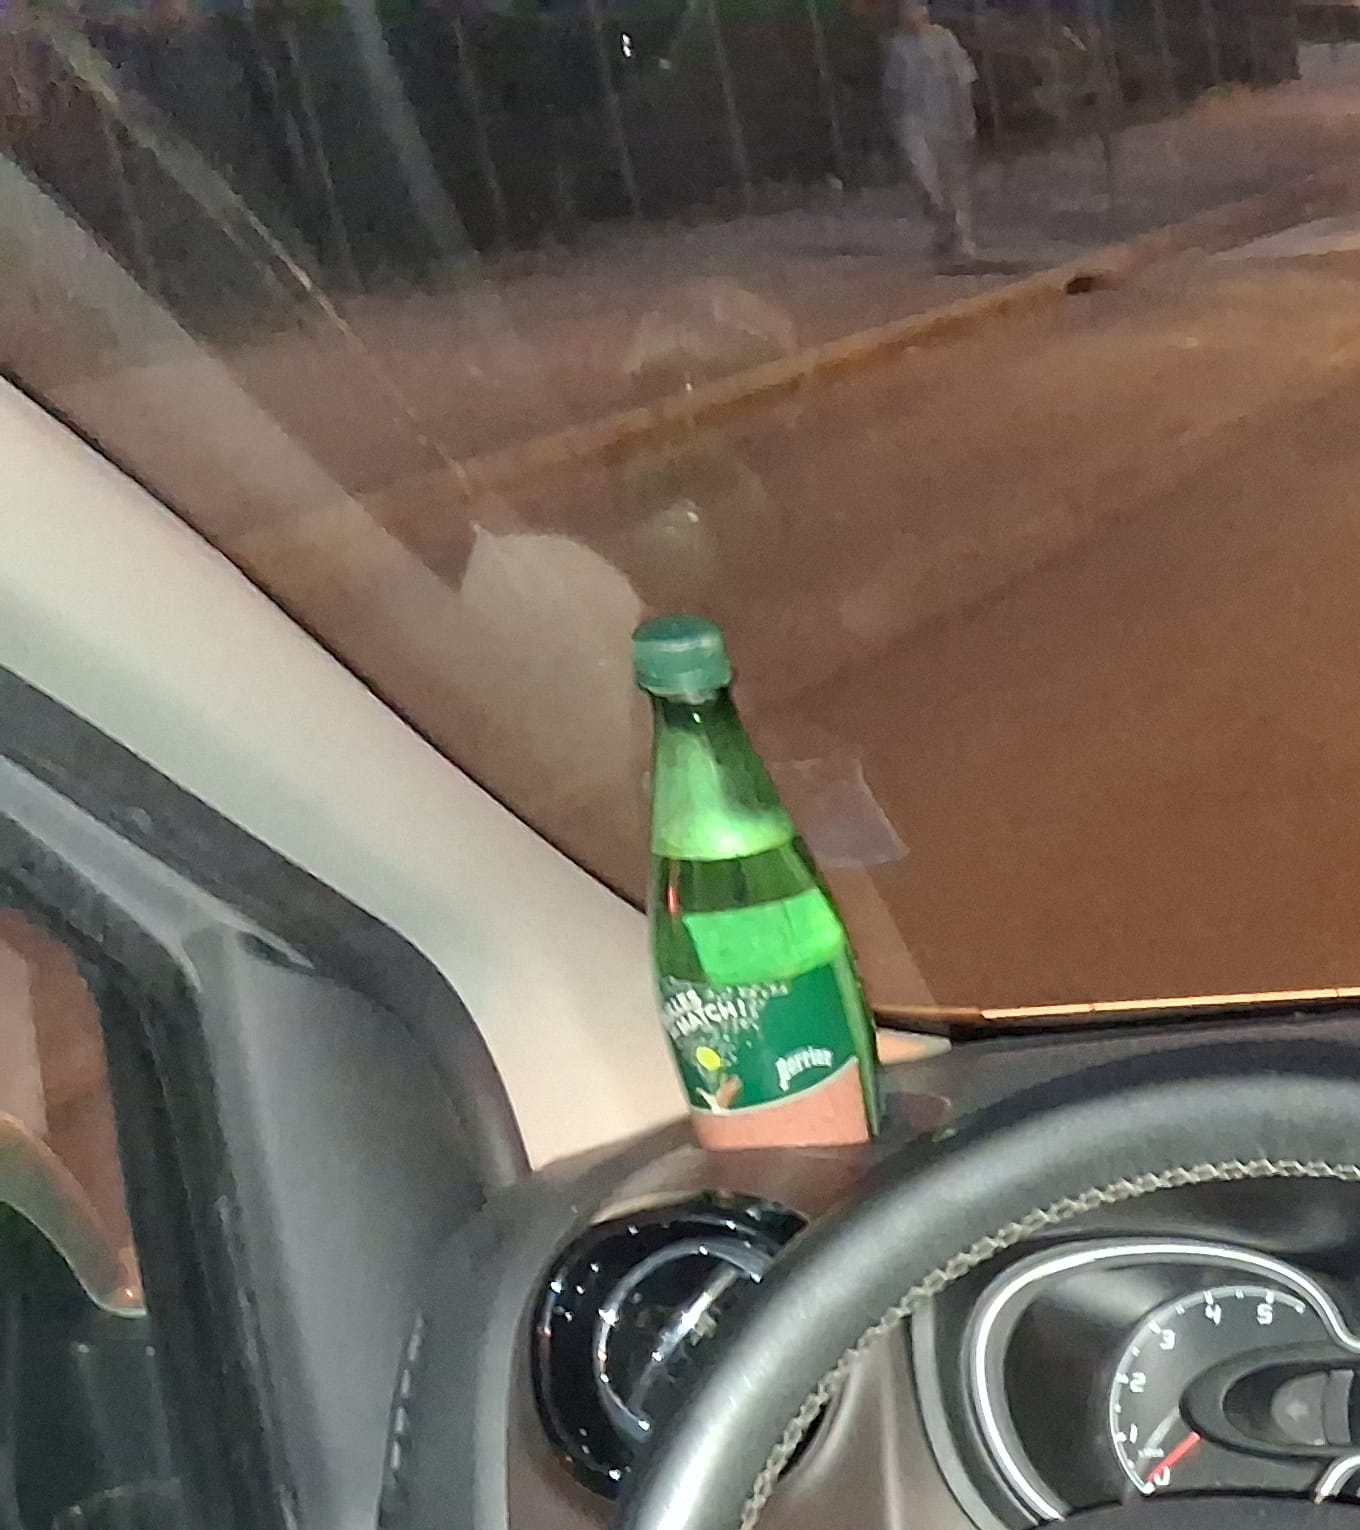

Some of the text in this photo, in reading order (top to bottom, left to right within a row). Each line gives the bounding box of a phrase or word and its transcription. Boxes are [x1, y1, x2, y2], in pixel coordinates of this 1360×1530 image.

[1205, 1304, 1222, 1326] 4
[1256, 1303, 1273, 1325] 5
[1160, 1329, 1176, 1350] 3
[1129, 1372, 1147, 1393] 2
[1129, 1423, 1138, 1444] 1
